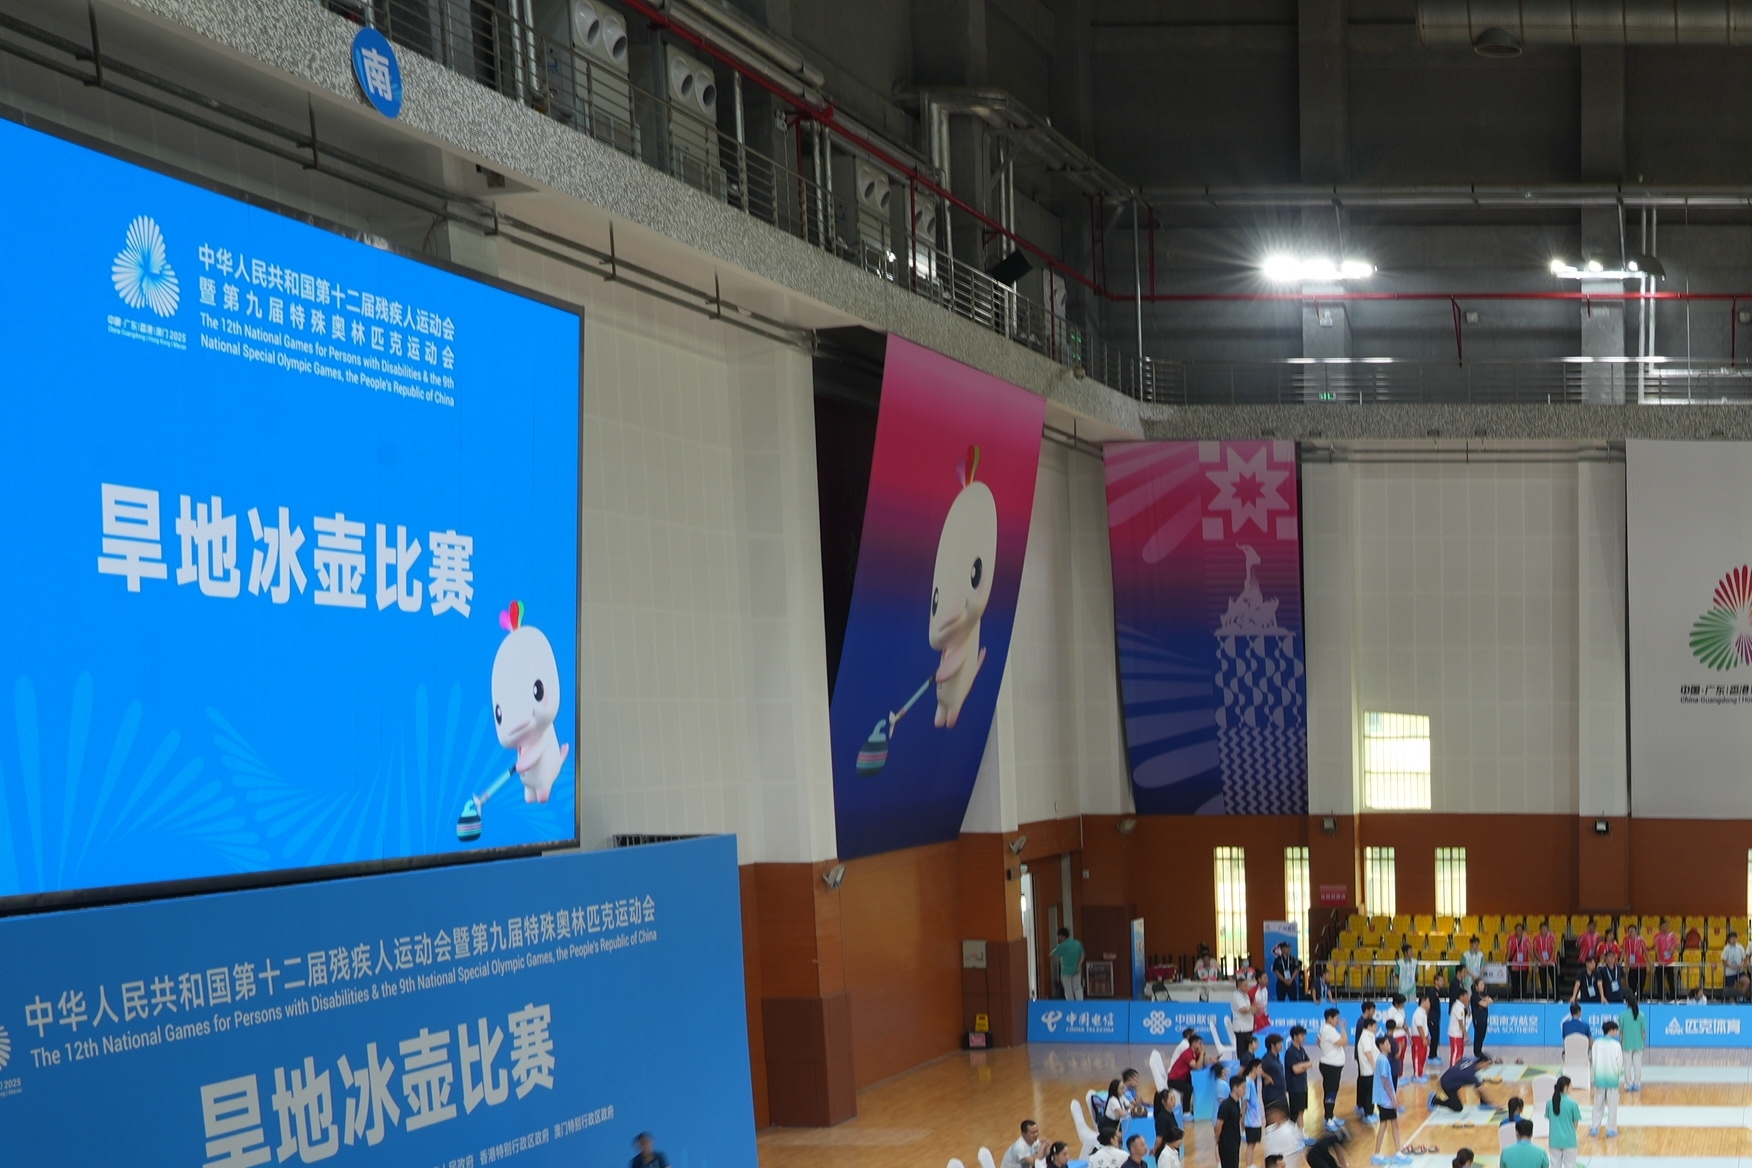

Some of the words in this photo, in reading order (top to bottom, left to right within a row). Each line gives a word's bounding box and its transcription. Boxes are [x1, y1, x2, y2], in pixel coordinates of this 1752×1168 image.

[361, 46, 393, 102] 南
[198, 242, 455, 342] 中华人民共和国第十二届残疾人运动会
[199, 276, 455, 370] 暨第九届特殊奥林匹克运动会
[200, 311, 218, 330] The
[221, 316, 242, 336] 12th
[244, 323, 282, 347] National
[284, 333, 313, 354] Games
[315, 341, 327, 358] for
[329, 345, 361, 366] Persons
[363, 354, 380, 371] with
[382, 356, 422, 382] Disabilities
[423, 370, 428, 383] &
[430, 370, 441, 386] the
[443, 374, 455, 390] 9th
[201, 332, 240, 356] National
[243, 344, 275, 365] Special
[278, 351, 312, 375] Olympic
[314, 361, 344, 382] Games,
[346, 367, 359, 384] the
[360, 373, 392, 393] People's
[394, 382, 424, 401] Republic
[426, 388, 433, 402] of
[435, 389, 455, 407] China
[97, 482, 476, 618] 旱地冰壶比赛
[25, 893, 656, 1039] 中华人民共和国第十二届残疾人运动会暨第九届特殊奥林匹克运动会
[31, 1047, 61, 1069] The
[65, 1037, 99, 1062] 12th
[102, 1030, 162, 1057] National
[165, 1019, 211, 1042] Games
[214, 1013, 232, 1034] for
[234, 1005, 283, 1030] Persons
[285, 996, 310, 1017] with
[312, 980, 369, 1013] Disabilities
[372, 984, 380, 1000] &
[381, 979, 398, 997] the
[399, 974, 416, 994] 9th
[417, 969, 456, 991] National
[458, 963, 490, 985] Special
[491, 954, 525, 977] Olympic
[527, 948, 555, 968] Games,
[556, 946, 568, 961] the
[569, 940, 600, 961] People's
[600, 934, 629, 954] Republic
[630, 932, 638, 946] of
[639, 928, 657, 944] China
[1066, 1011, 1114, 1027] 中国电信
[1487, 1014, 1538, 1027] 国南方航空
[1685, 1018, 1741, 1035] 匹克体育
[479, 1127, 550, 1166] 香港特别行政区政府
[554, 1104, 614, 1140] 澳门特别行政区政府
